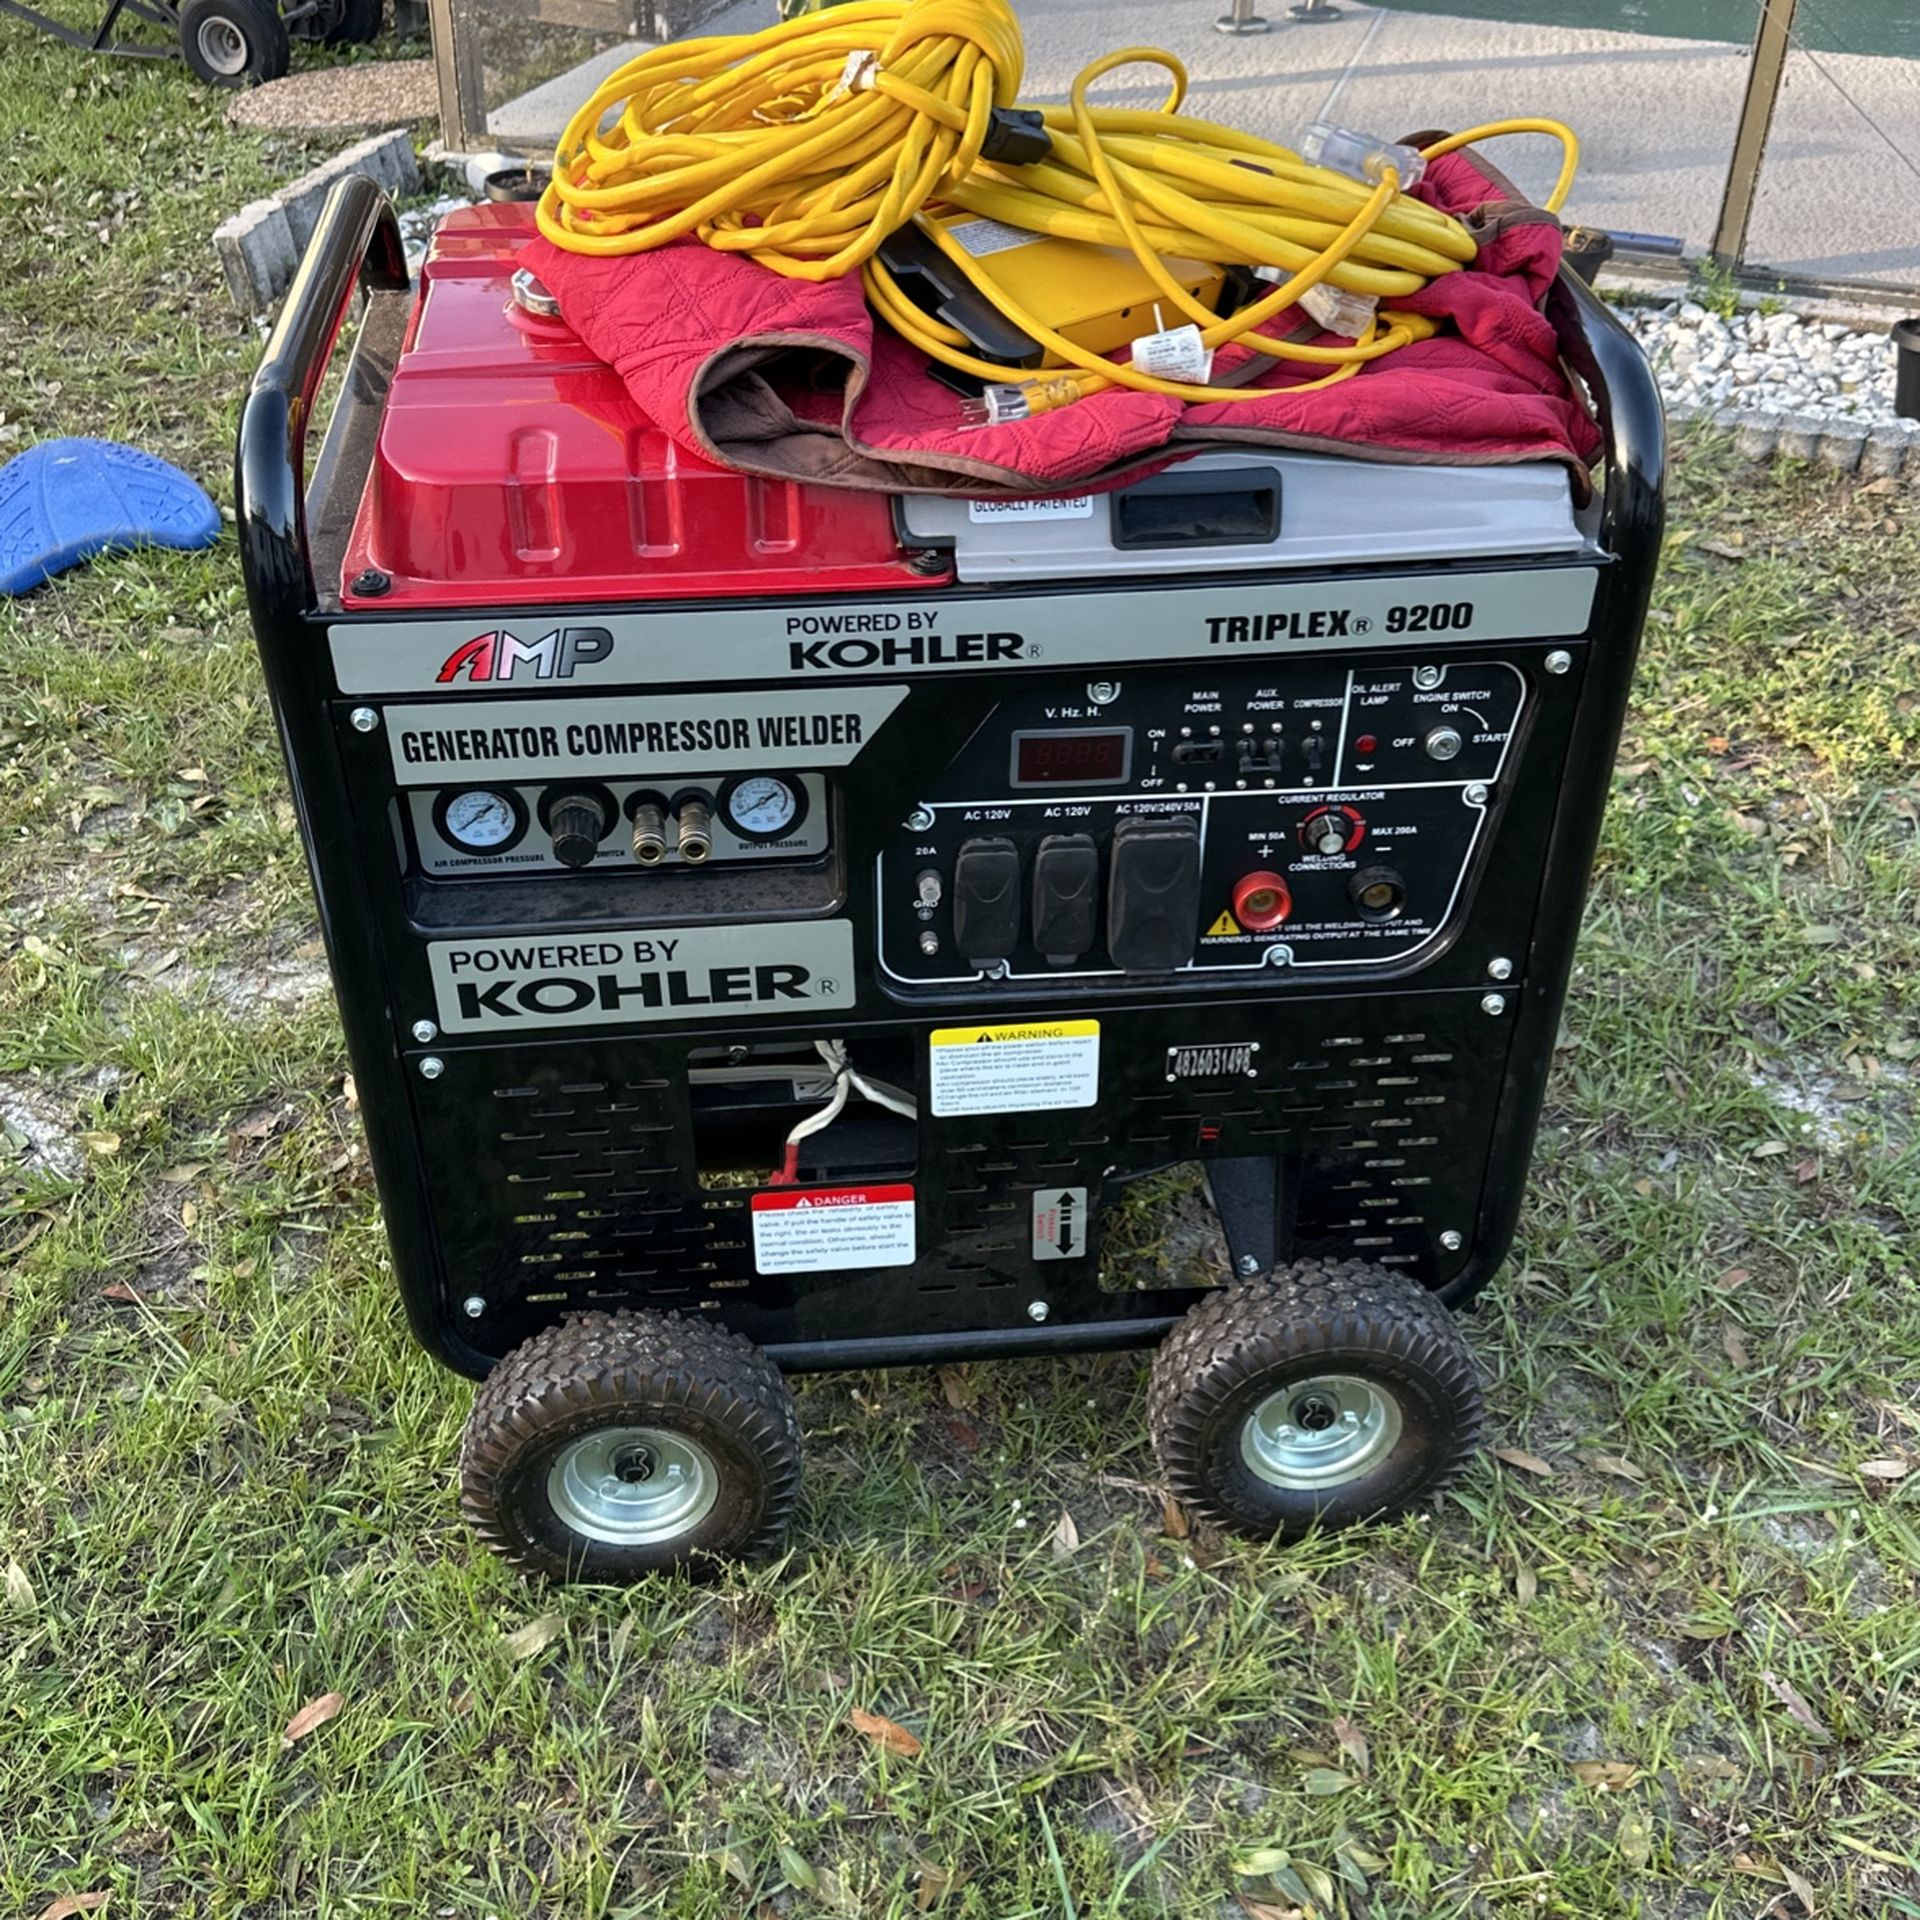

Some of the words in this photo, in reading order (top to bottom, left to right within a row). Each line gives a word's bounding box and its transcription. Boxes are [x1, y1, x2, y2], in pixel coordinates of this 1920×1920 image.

[974, 501, 1028, 512] GLOBALLY
[1033, 496, 1088, 509] PATENTED
[787, 613, 901, 635] POWERED
[908, 611, 938, 630] BY
[1385, 602, 1474, 633] 9200
[435, 626, 614, 683] AMP
[1352, 684, 1367, 694] OIL
[1369, 683, 1402, 693] ALERT
[1192, 691, 1219, 700] MAIN
[1360, 695, 1389, 705] LAMP
[1413, 692, 1450, 703] ENGINE
[1452, 690, 1491, 701] SWITCH
[1184, 703, 1222, 712] POWER
[1246, 700, 1284, 710] POWER
[1293, 697, 1344, 708] COMPRESSOR
[1441, 704, 1459, 713] ON
[401, 727, 559, 763] GENERATOR
[566, 718, 750, 756] COMPRESSOR
[757, 713, 862, 747] WELDER
[1147, 729, 1165, 738] ON
[1472, 733, 1509, 743] START
[1392, 738, 1416, 747] OFF
[1140, 779, 1164, 787] OFF
[1278, 794, 1325, 804] CURRENT
[1326, 791, 1385, 802] REGULATOR
[1044, 808, 1061, 817] AC
[1063, 806, 1092, 817] 120V
[1115, 804, 1130, 814] AC
[964, 810, 981, 821] AC
[983, 809, 1011, 820] 120V
[1248, 833, 1267, 841] MIN
[1371, 827, 1393, 836] MAX
[739, 842, 768, 850] OUTPUT
[770, 840, 808, 848] PRESSURE
[915, 846, 937, 855] 20A
[434, 860, 448, 868] AIR
[450, 857, 503, 867] COMPRESSOR
[505, 854, 544, 863] PRESSURE
[1288, 861, 1356, 871] CONNECTIONS
[1200, 935, 1251, 945] WARNING
[1254, 933, 1311, 942] GENERATING
[449, 943, 623, 973] POWERED
[634, 939, 679, 962] BY
[994, 1028, 1063, 1041] WARNING
[814, 1194, 867, 1206] DANGER
